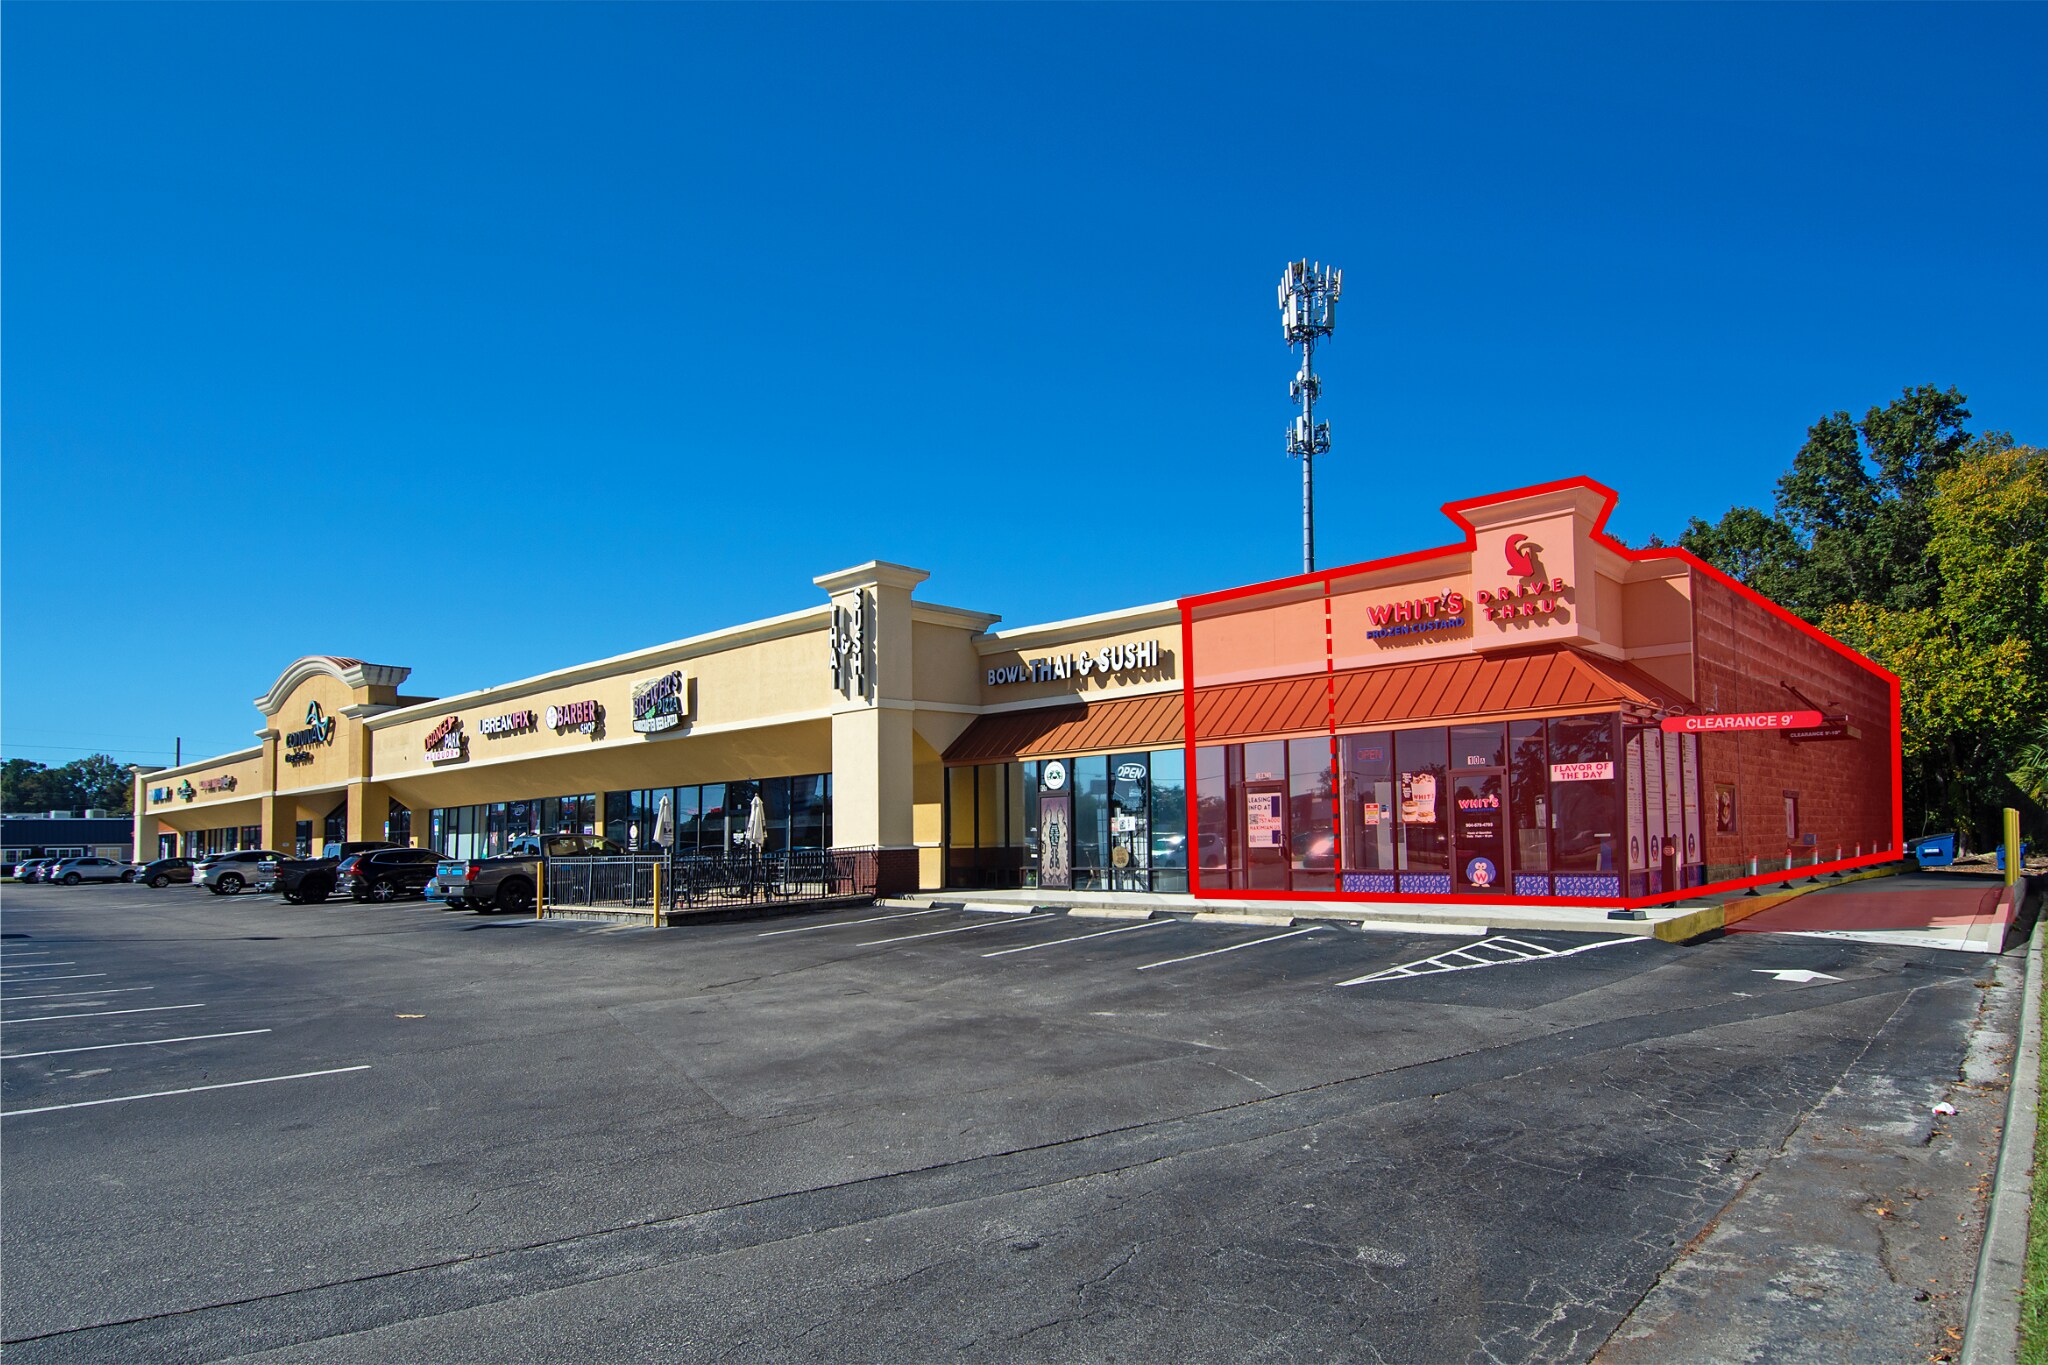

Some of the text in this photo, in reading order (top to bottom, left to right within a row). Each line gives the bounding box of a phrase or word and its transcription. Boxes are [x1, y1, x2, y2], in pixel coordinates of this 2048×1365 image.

[1477, 578, 1563, 604] DRIVE
[1366, 590, 1464, 625] WHIT'S
[1484, 599, 1556, 621] THRU
[1366, 617, 1465, 639] FROZEN CUSTARD
[829, 588, 863, 696] THAI & SUSHI
[988, 640, 1159, 686] BOWL THAI & SUSHI
[557, 700, 597, 726] BARBER
[657, 697, 679, 714] PIZZA
[479, 711, 530, 735] UBREAKIFIX
[580, 721, 596, 735] SHOP
[1686, 715, 1794, 730] CLEARANCE 9'
[445, 732, 461, 748] PARK
[1358, 749, 1382, 760] OPEN
[1118, 766, 1144, 779] OPEN
[1554, 763, 1609, 773] FLAVOR OF
[1561, 771, 1603, 780] THE DAY
[1458, 797, 1500, 809] WHIT'S
[1475, 873, 1487, 883] W
